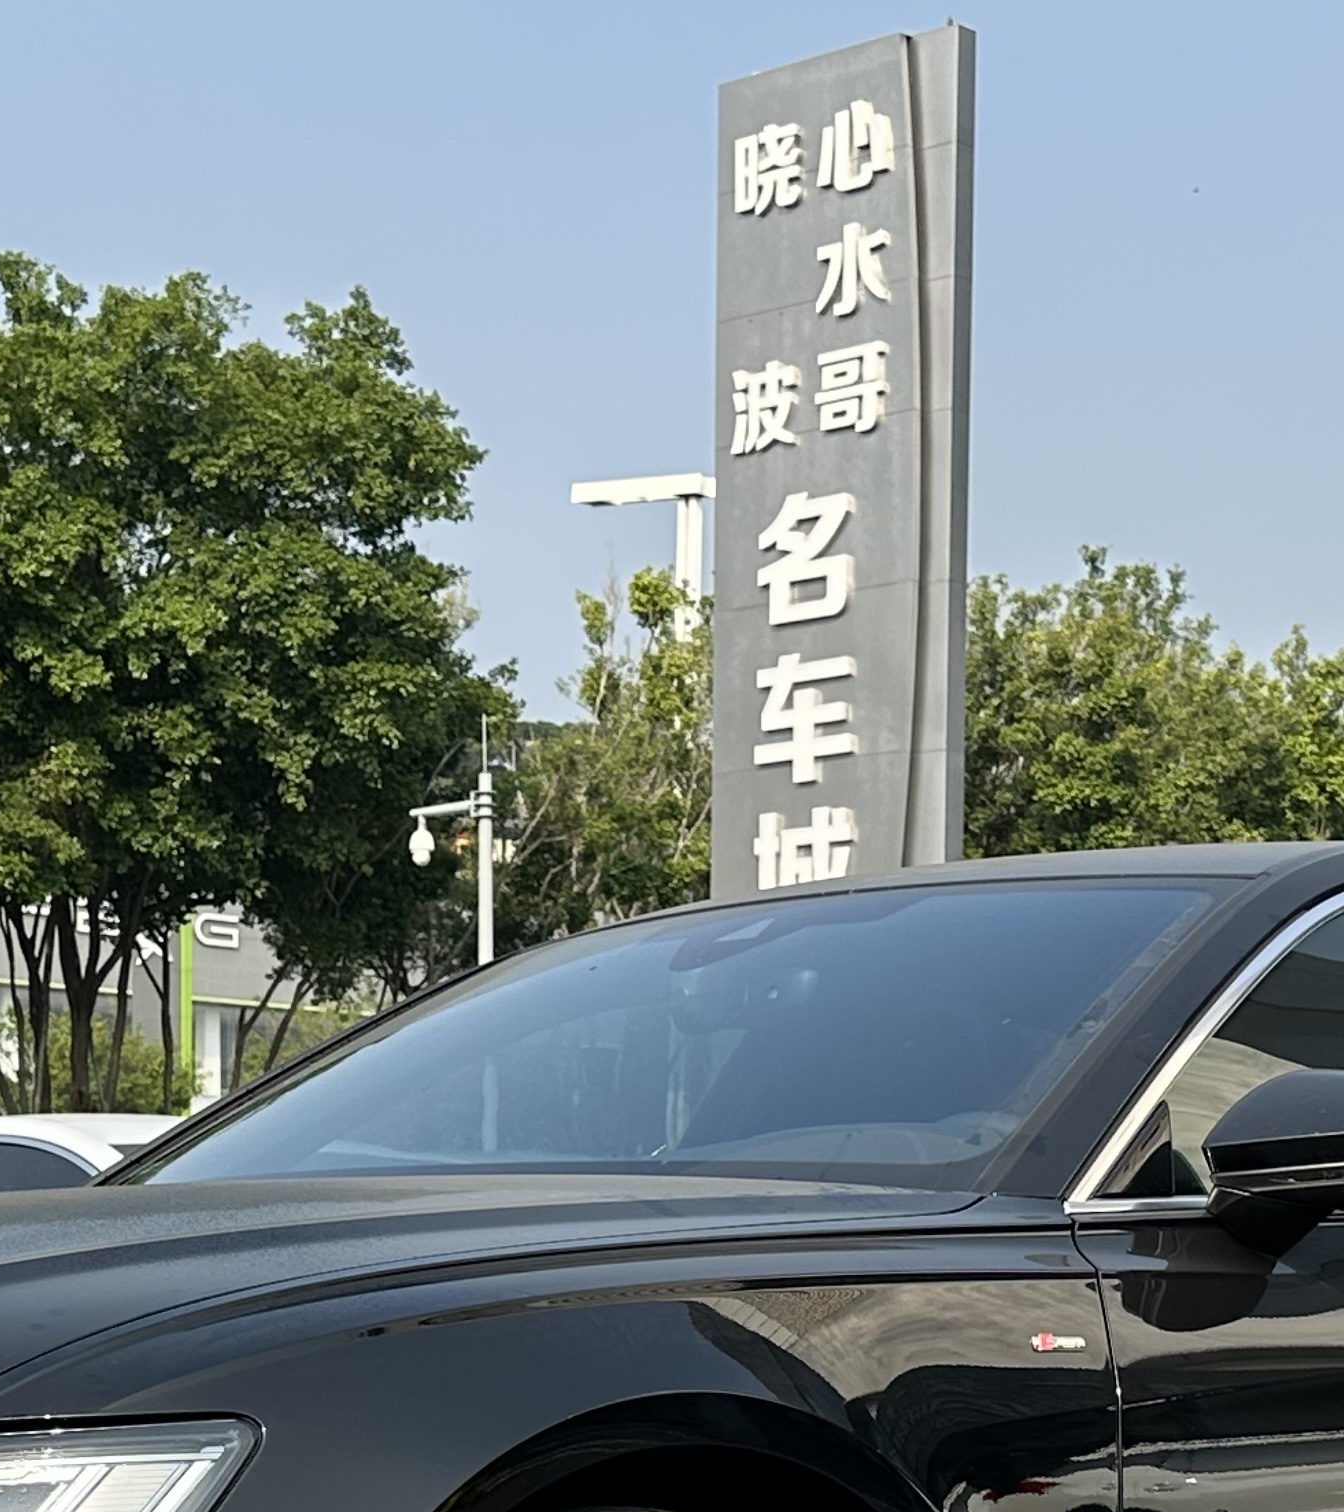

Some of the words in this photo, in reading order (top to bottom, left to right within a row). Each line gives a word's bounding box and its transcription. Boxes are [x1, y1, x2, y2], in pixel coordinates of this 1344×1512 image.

[731, 122, 805, 455] 晓波
[815, 99, 894, 433] 心水哥
[754, 491, 859, 890] 名车城
